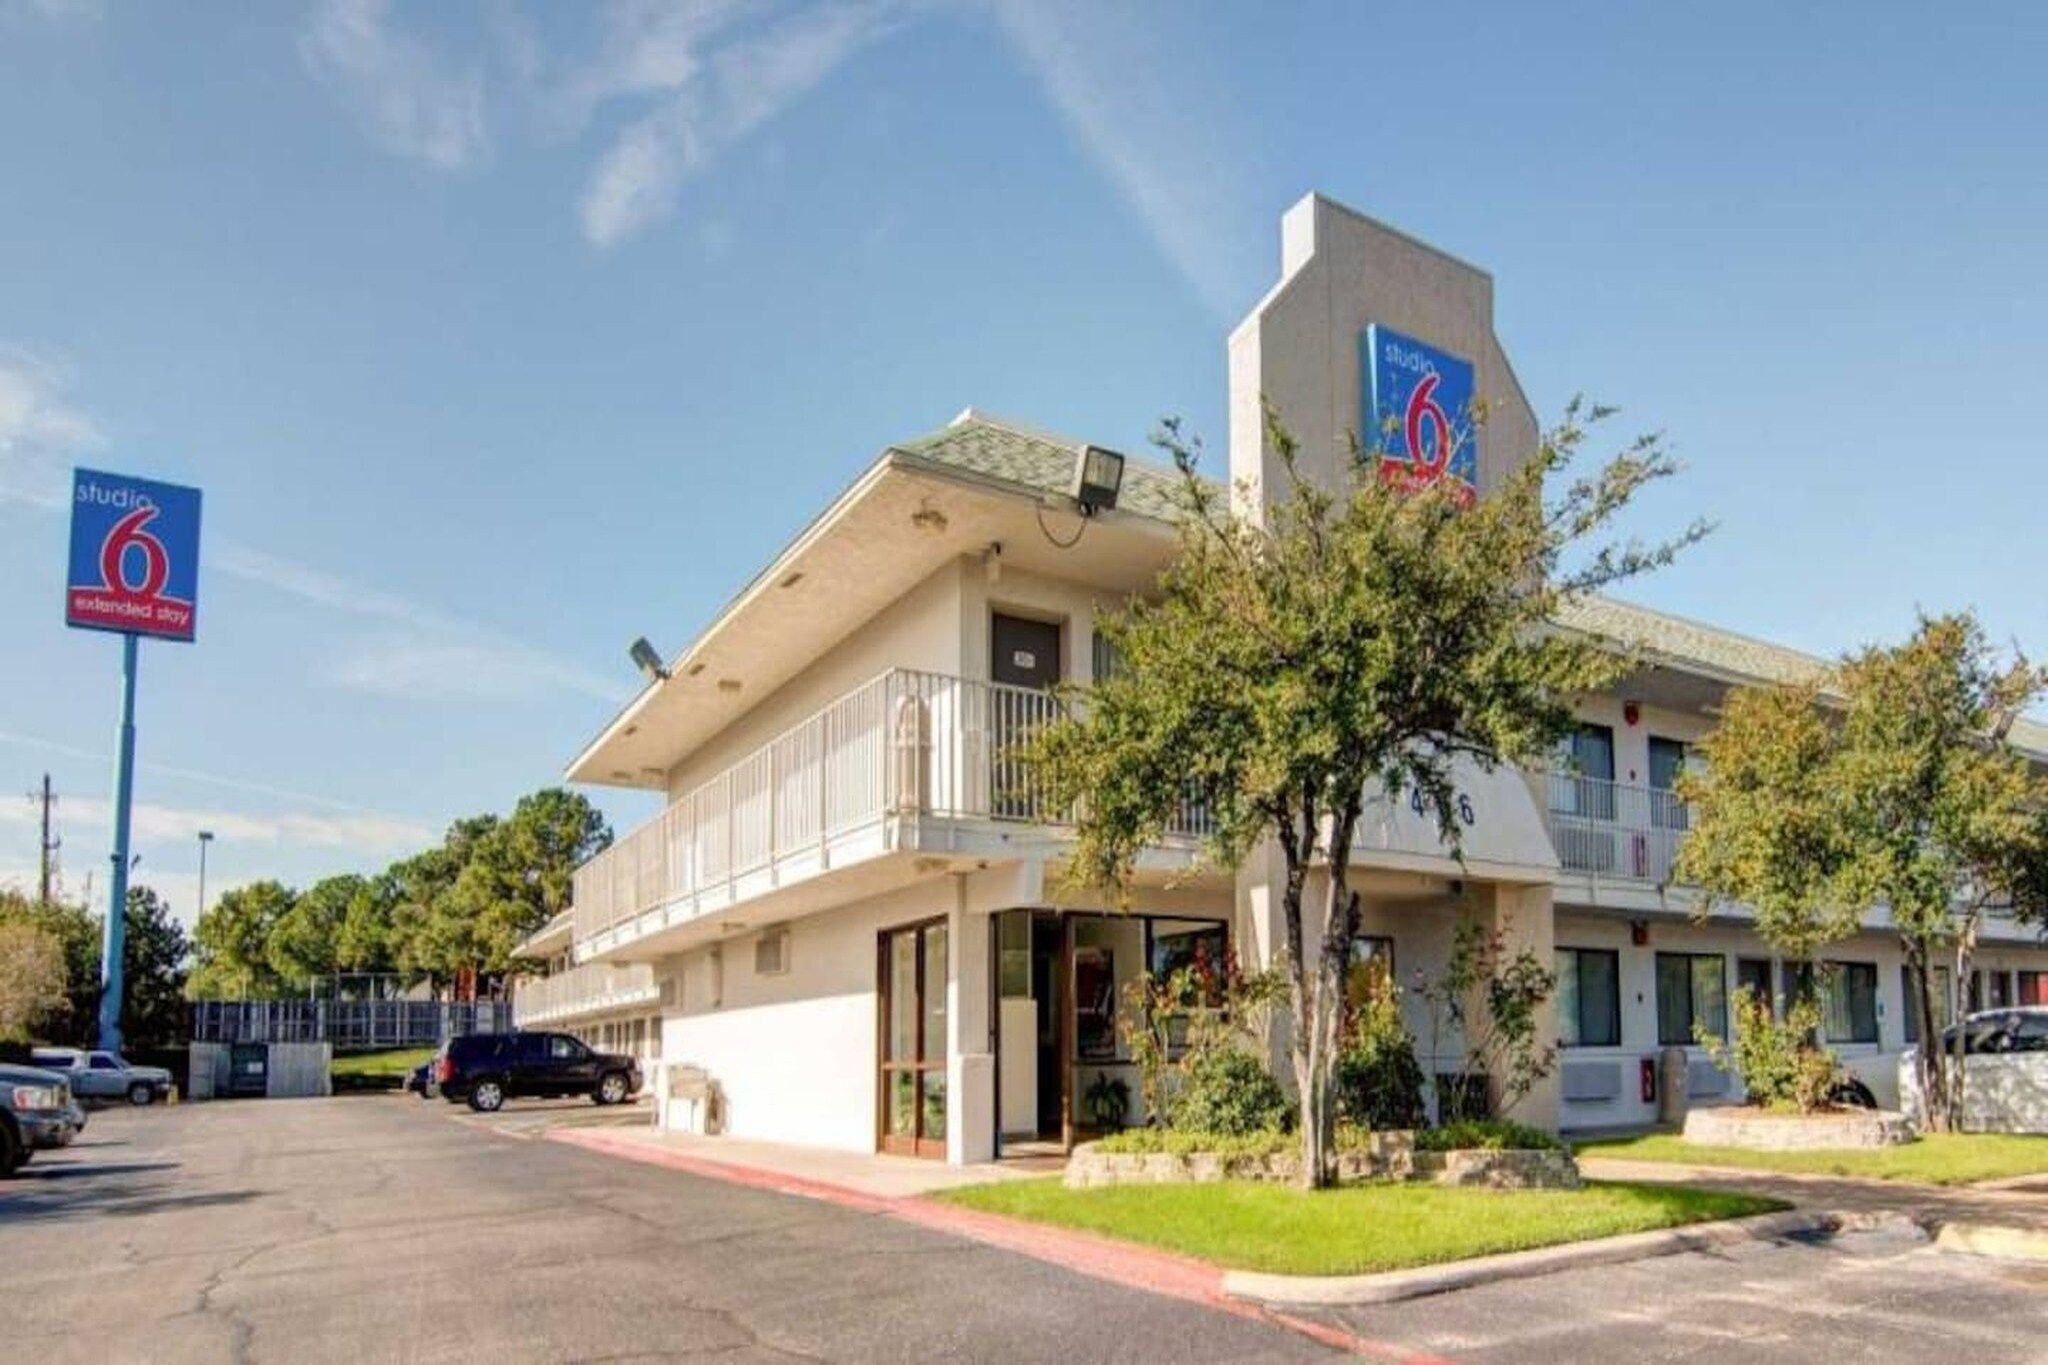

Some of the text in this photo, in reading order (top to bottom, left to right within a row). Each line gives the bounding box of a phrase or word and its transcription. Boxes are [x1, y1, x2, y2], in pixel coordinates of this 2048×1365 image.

[1385, 343, 1435, 374] studio
[1404, 371, 1452, 475] 6
[76, 482, 152, 508] studio
[99, 505, 170, 598] 6
[73, 597, 189, 625] extended stay
